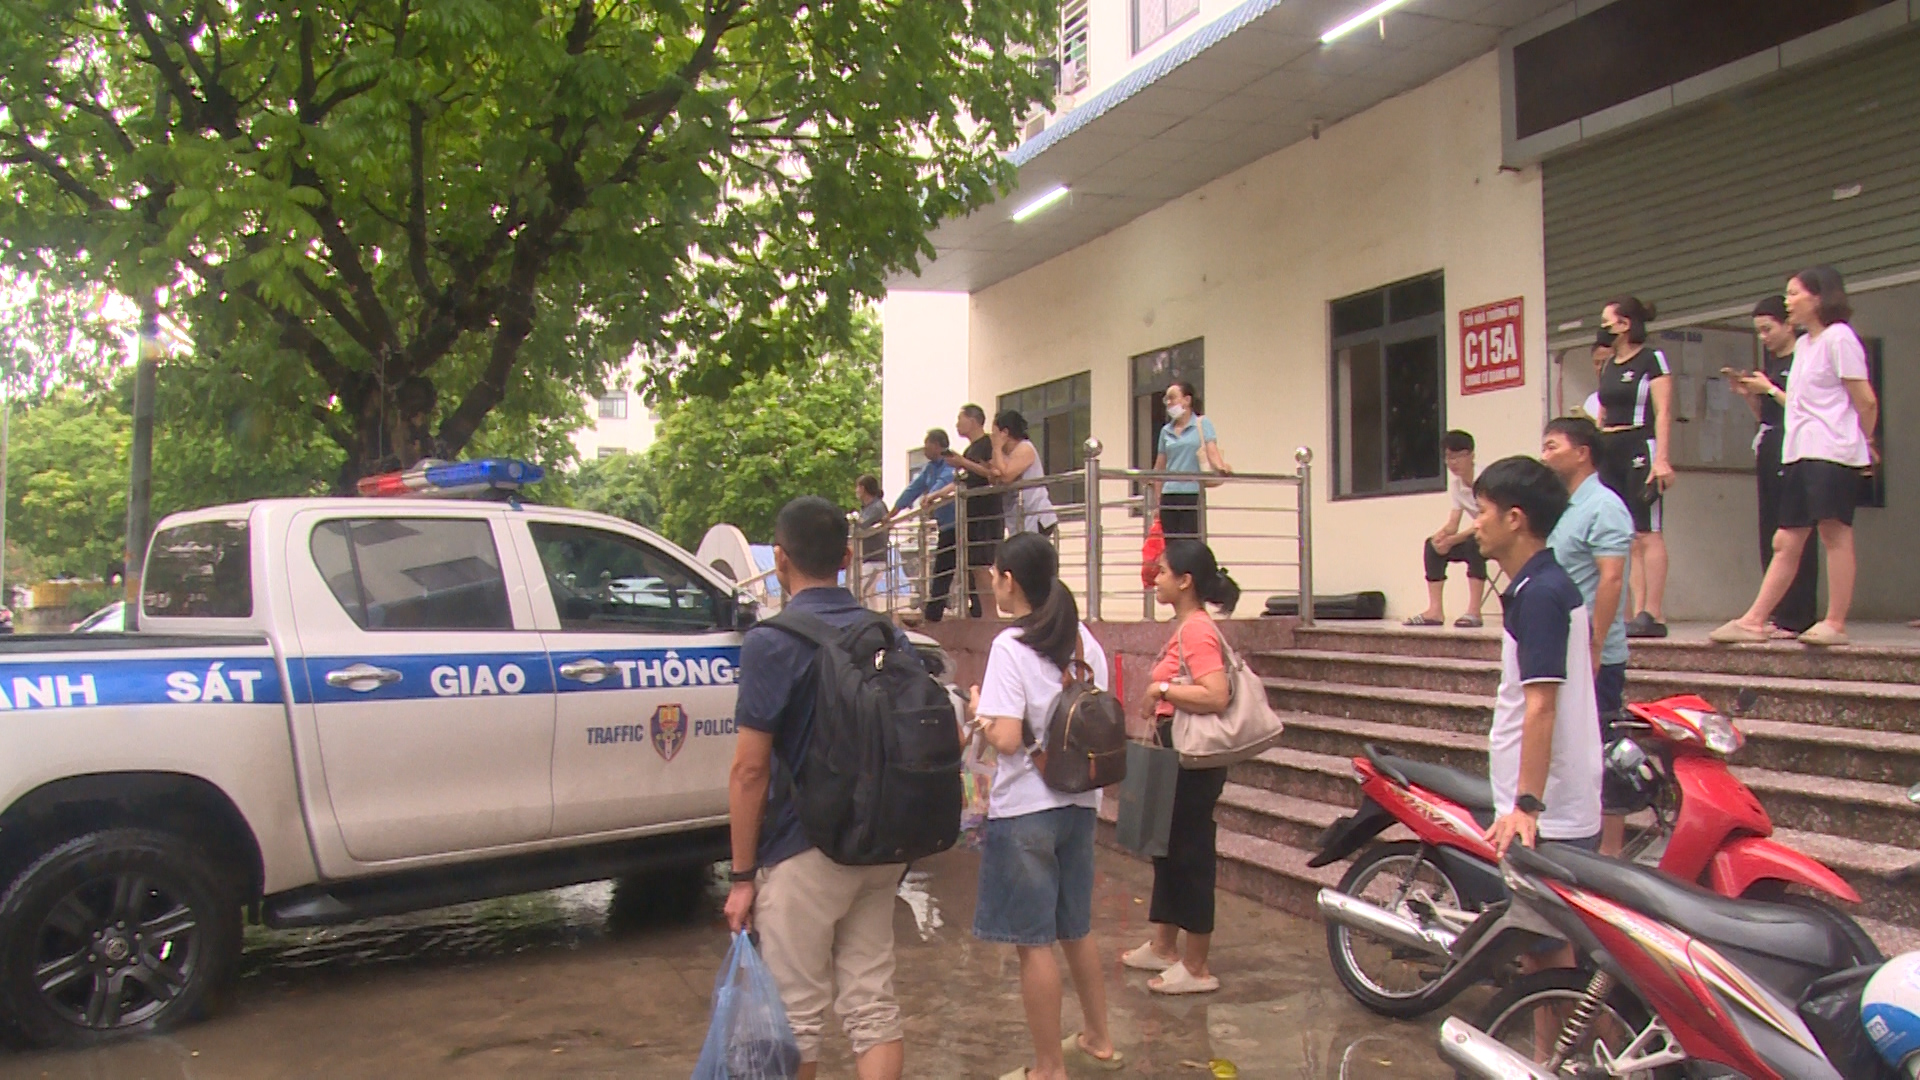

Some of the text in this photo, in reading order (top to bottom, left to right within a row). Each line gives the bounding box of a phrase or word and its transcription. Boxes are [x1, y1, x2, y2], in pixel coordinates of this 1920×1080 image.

[1464, 323, 1518, 370] C15A
[166, 662, 263, 703] SÁT
[430, 663, 526, 697] GIAO
[613, 650, 735, 687] THÔNG
[587, 724, 644, 744] TRAFFIC
